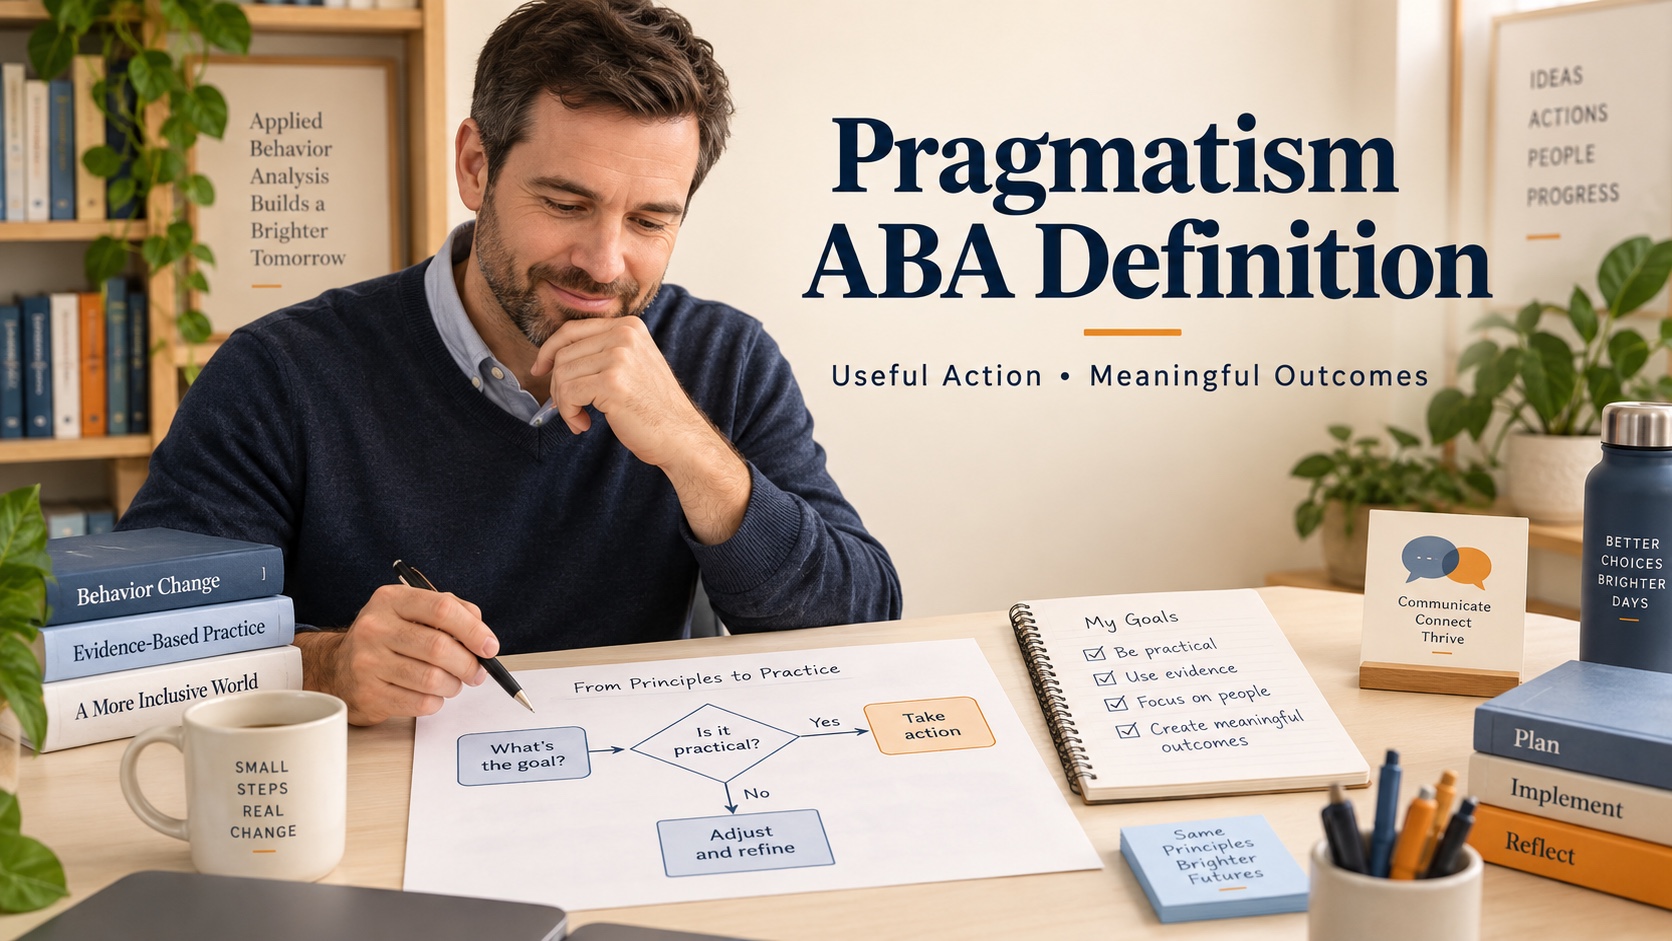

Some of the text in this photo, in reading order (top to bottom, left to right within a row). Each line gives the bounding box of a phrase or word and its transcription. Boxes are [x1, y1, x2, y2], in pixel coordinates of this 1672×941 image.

[1530, 65, 1584, 90] IDEAS
[249, 111, 323, 136] Applied
[1528, 102, 1609, 128] ACTIONS
[250, 138, 333, 158] Behavior
[1528, 143, 1595, 168] PEOPLE
[250, 166, 330, 190] Analysis
[251, 193, 326, 212] Builds a
[1527, 182, 1620, 206] PROGRESS
[251, 220, 329, 244] Brighter
[250, 249, 346, 267] Tomorrow
[1605, 535, 1660, 550] BETTER
[1601, 554, 1663, 570] CHOICES
[76, 575, 221, 607] Behavior Change
[1598, 573, 1666, 590] BRIGHTER
[1398, 595, 1491, 612] Communicate
[1612, 595, 1649, 609] DAYS
[1084, 609, 1179, 634] My Goals
[1415, 614, 1472, 628] Connect
[73, 619, 266, 662] Evidence-Based Practice
[1421, 631, 1465, 645] Thrive
[1113, 636, 1218, 661] Be practical
[573, 664, 841, 694] From Principles to Practice
[1125, 663, 1238, 683] Use evidence
[75, 671, 259, 721] A More Inclusive World
[1136, 684, 1271, 709] Focus on people
[809, 716, 841, 729] Yes
[901, 711, 946, 724] Take
[1150, 708, 1305, 736] Create meaningful
[696, 725, 731, 738] Is it
[904, 726, 962, 740] action
[490, 740, 554, 755] What's
[674, 737, 760, 758] practical?
[1161, 736, 1249, 753] outcomes
[1513, 728, 1560, 755] Plan
[235, 760, 289, 774] SMALL
[481, 755, 565, 772] the goal?
[237, 781, 288, 796] STEPS
[743, 787, 770, 800] No
[1511, 778, 1623, 819] Implement
[242, 804, 284, 818] REAL
[229, 824, 296, 839] CHANGE
[710, 825, 774, 843] Adjust
[1173, 828, 1226, 841] Same
[696, 842, 796, 861] and refine
[1163, 837, 1254, 856] Principles
[1505, 831, 1575, 865] Reflect
[1176, 853, 1257, 872] Brighter
[1188, 868, 1264, 885] Futures
